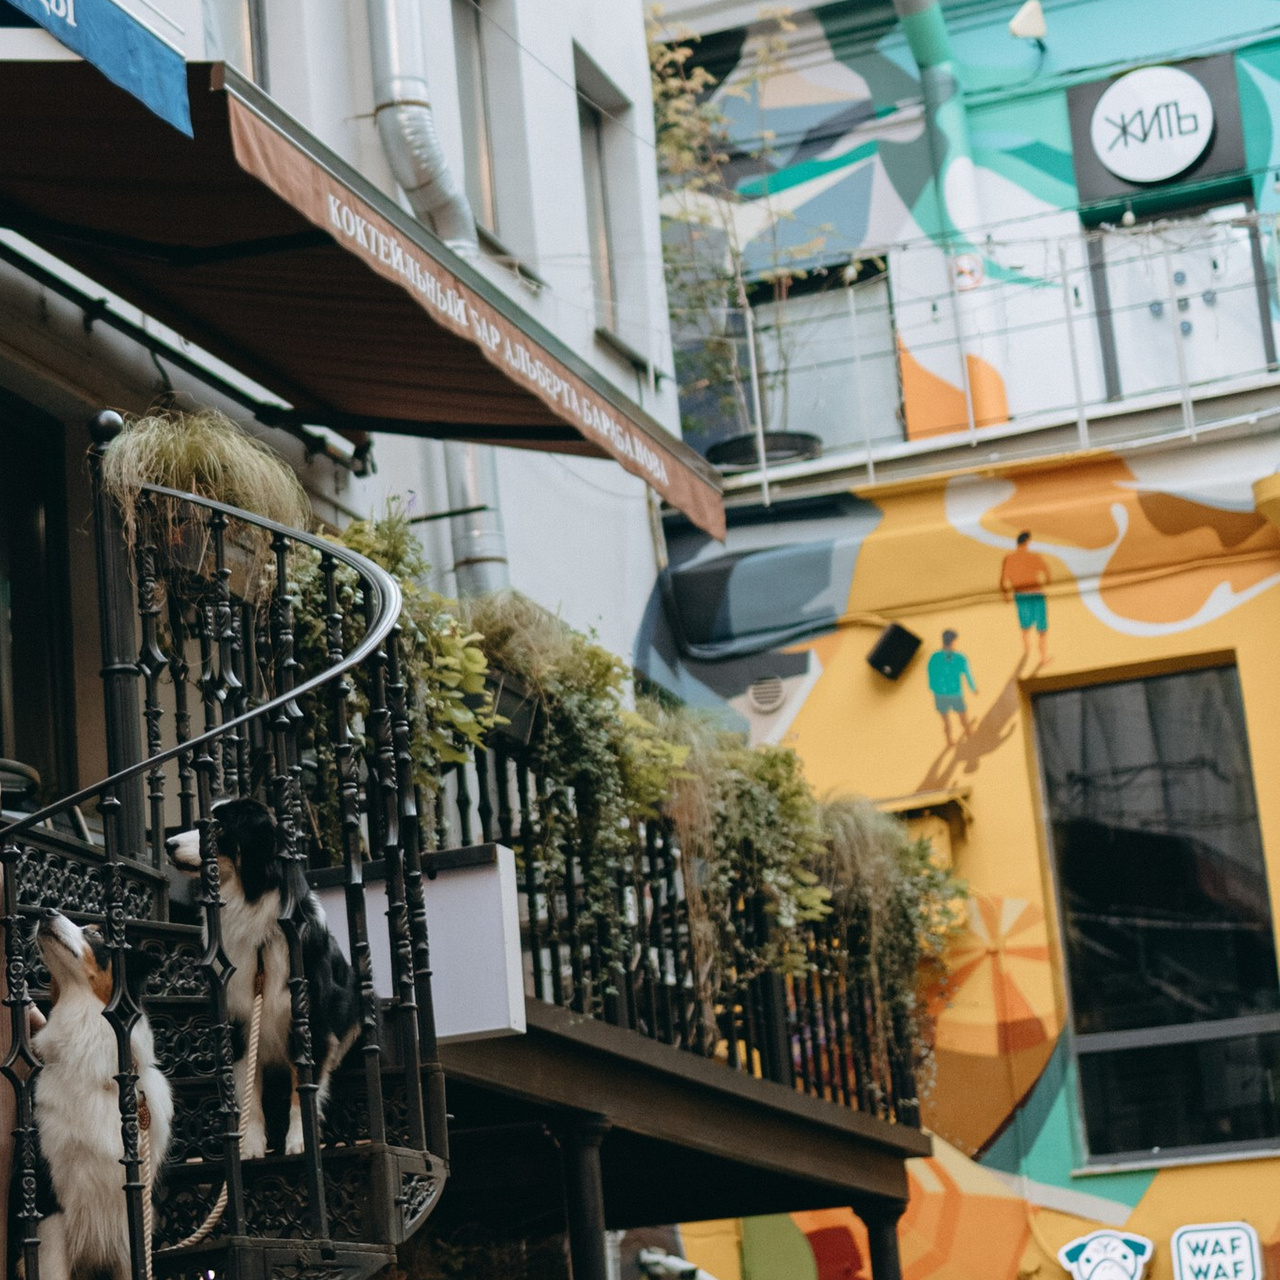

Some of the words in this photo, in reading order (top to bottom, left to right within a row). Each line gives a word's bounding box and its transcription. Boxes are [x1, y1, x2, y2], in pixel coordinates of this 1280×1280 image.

[1103, 100, 1200, 152] ЖИТЬ
[327, 193, 469, 327] КОКТЕЙЛЬНЫЙ
[469, 307, 501, 352] БАР
[504, 337, 582, 416] АЛЬБЕРТА
[1186, 1236, 1242, 1257] WAF
[1189, 1260, 1245, 1280] WAF
